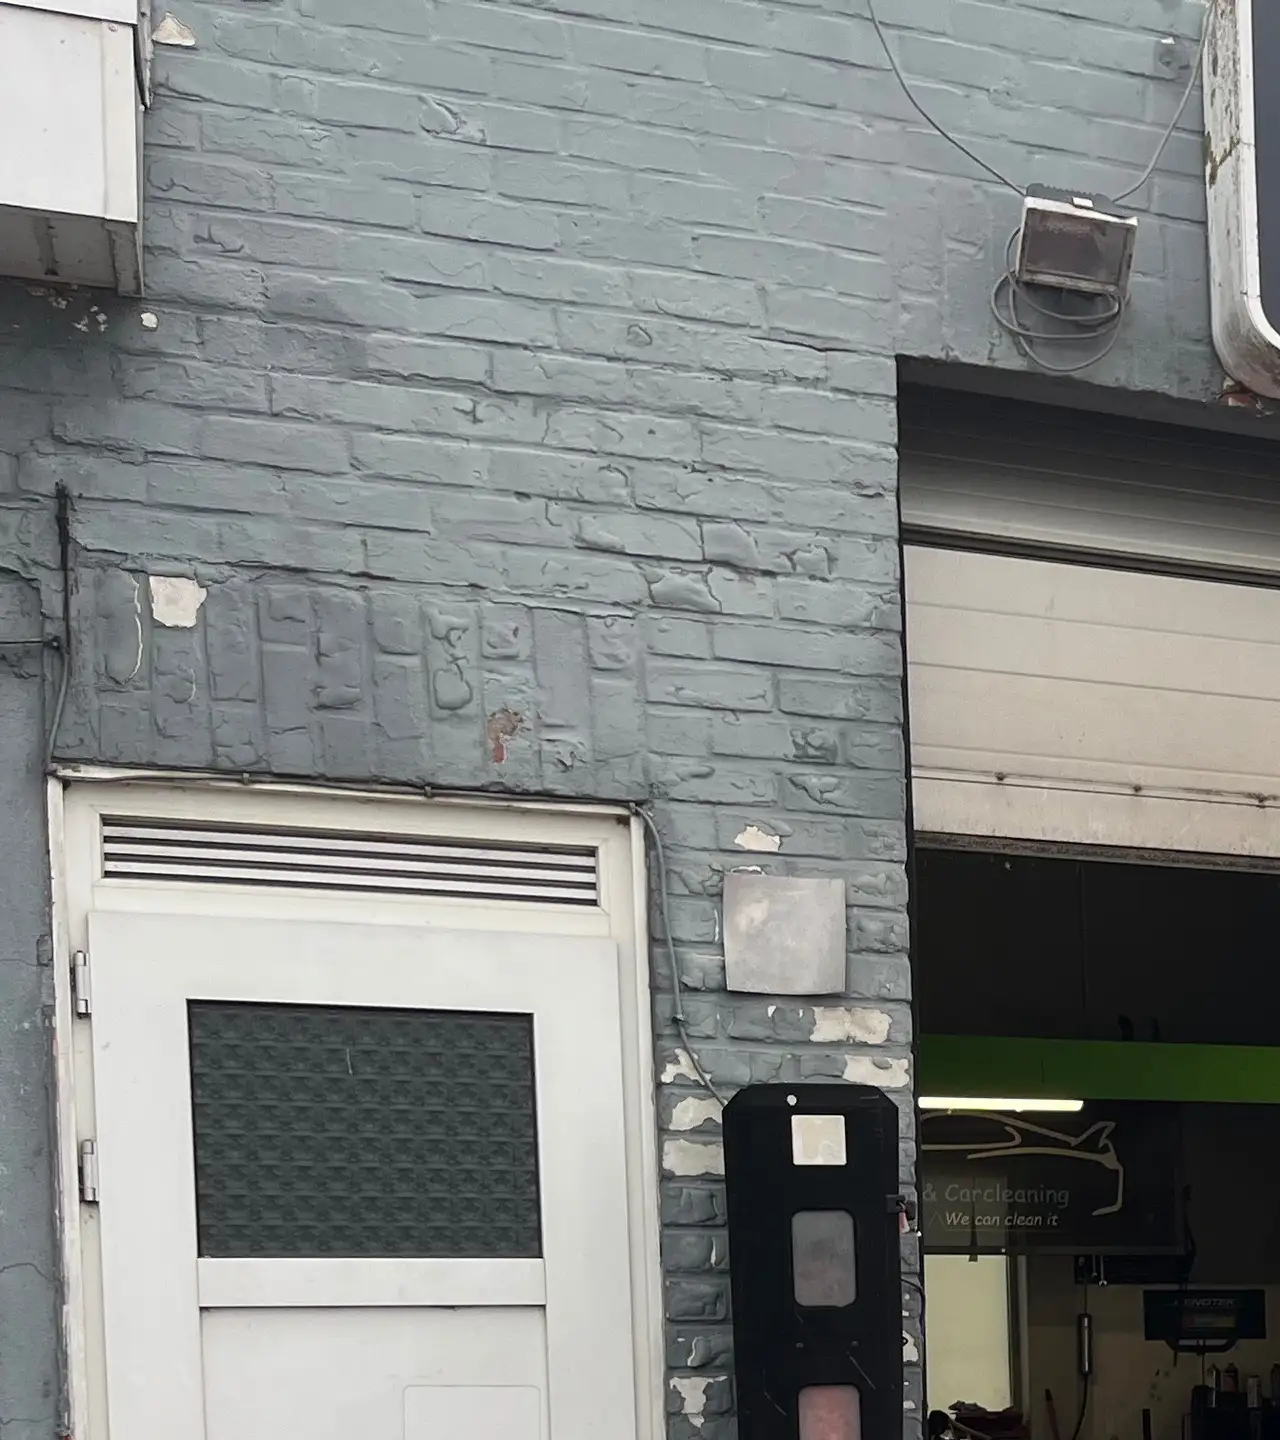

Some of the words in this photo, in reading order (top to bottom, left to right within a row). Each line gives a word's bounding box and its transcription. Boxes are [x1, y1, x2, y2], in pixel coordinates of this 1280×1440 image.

[945, 1182, 1070, 1208] Carcleaning
[945, 1211, 970, 1226] We
[974, 1215, 1000, 1226] can
[1004, 1211, 1042, 1226] clean
